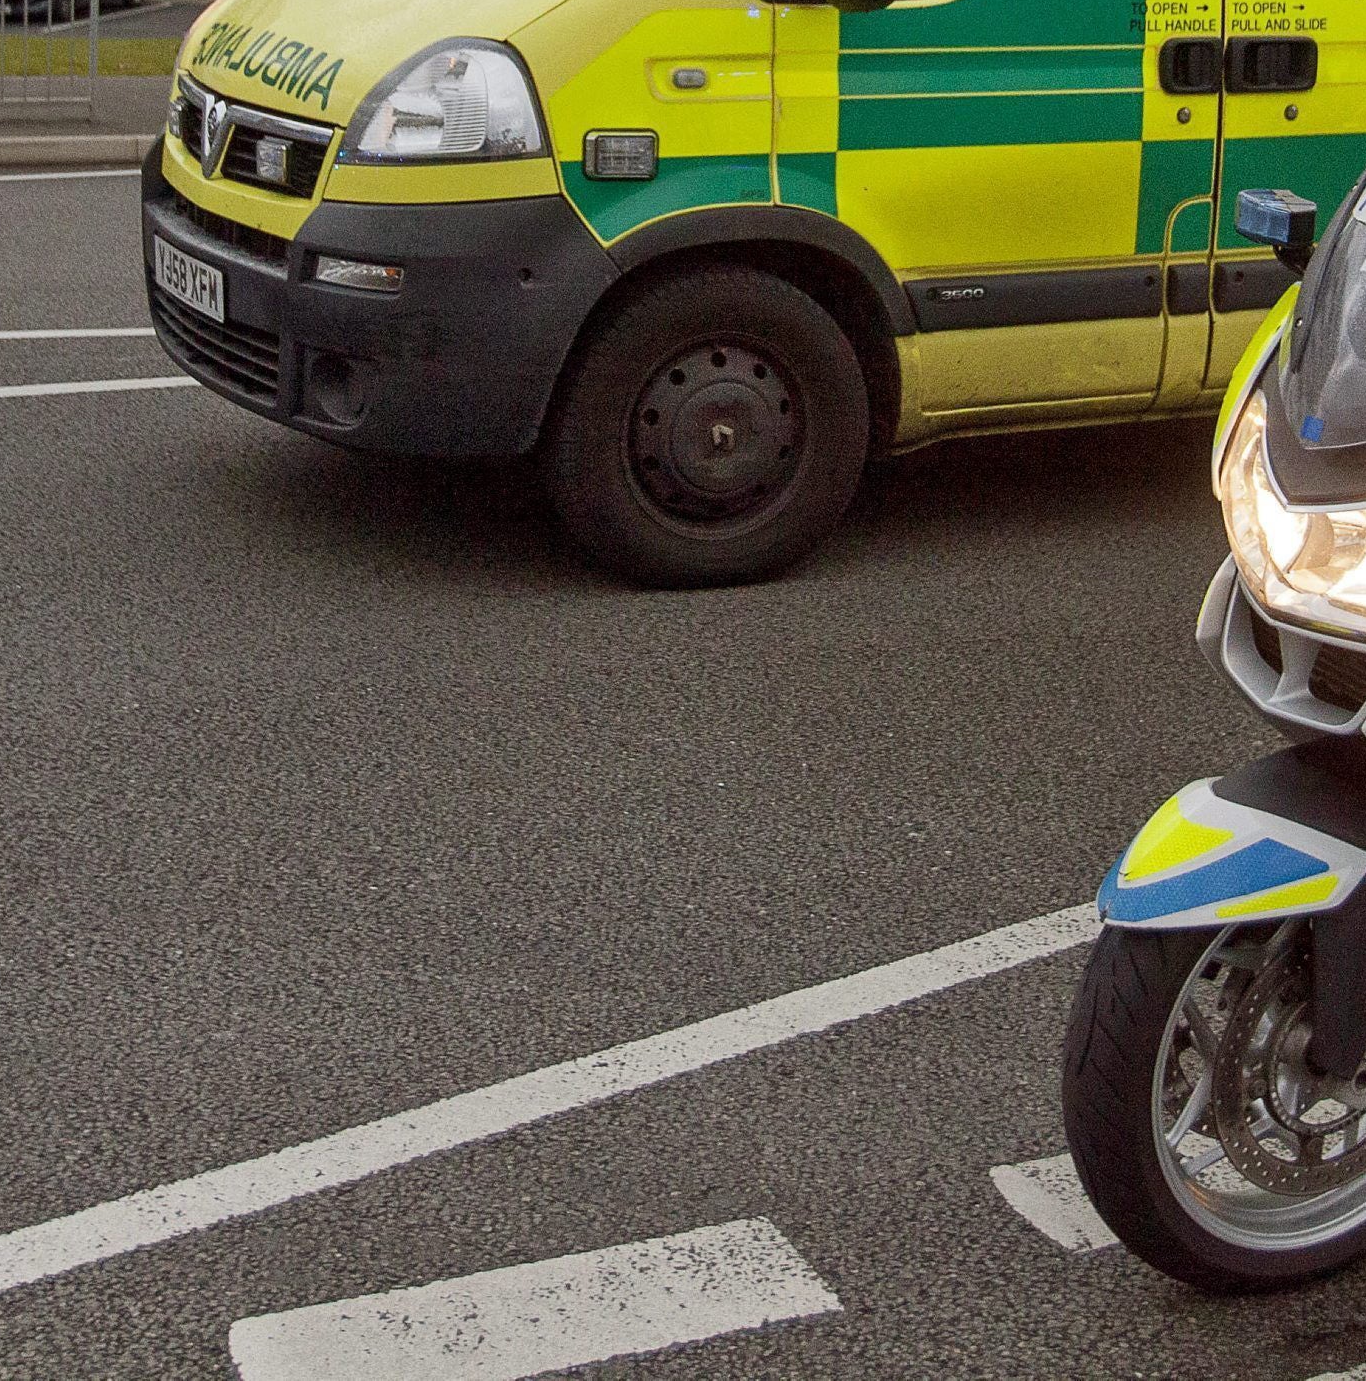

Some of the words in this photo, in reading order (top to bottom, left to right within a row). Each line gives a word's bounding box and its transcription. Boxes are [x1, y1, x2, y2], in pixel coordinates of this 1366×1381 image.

[1131, 2, 1148, 15] TO
[1152, 2, 1188, 15] OPEN
[1233, 2, 1249, 15] TO
[1252, 2, 1287, 14] OPEN
[1129, 19, 1161, 32] PULL
[1165, 19, 1217, 32] HANDLE
[1231, 19, 1261, 31] PULL
[1265, 19, 1291, 31] AND
[1295, 18, 1327, 30] SLIDE
